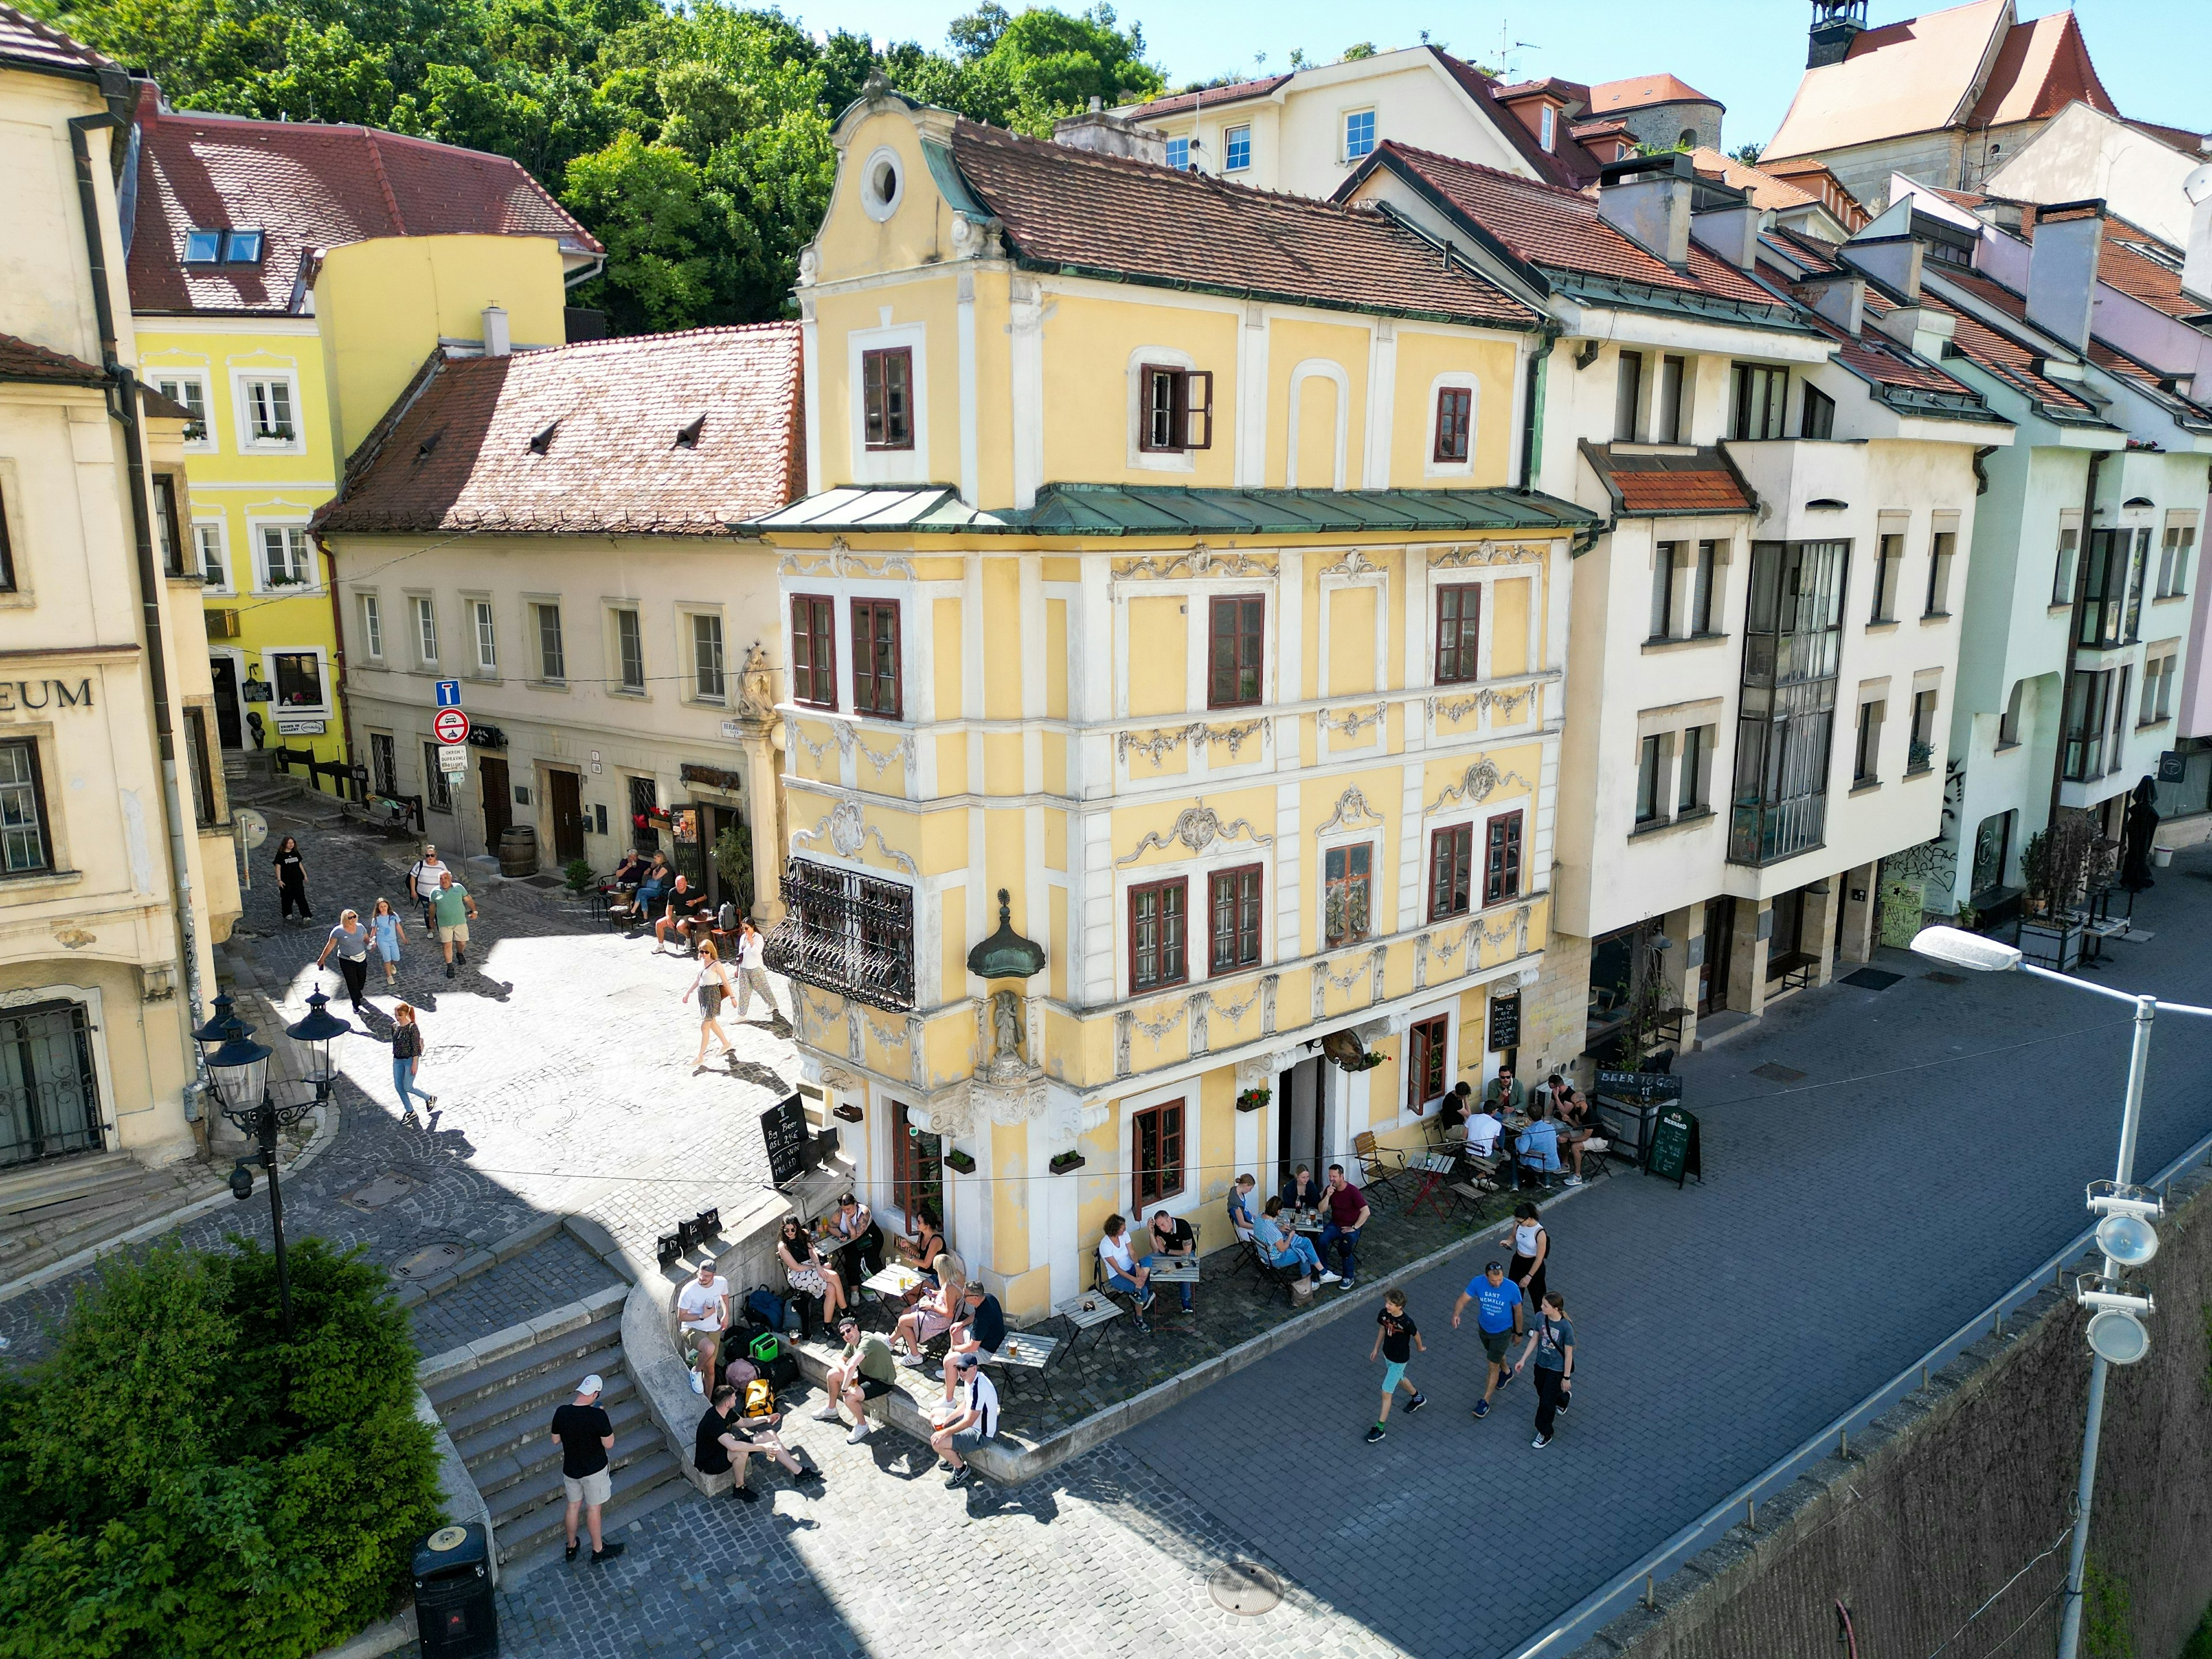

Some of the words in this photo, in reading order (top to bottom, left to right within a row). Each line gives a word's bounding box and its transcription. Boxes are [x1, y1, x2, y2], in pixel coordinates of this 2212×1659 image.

[1601, 1073, 1634, 1084] BEER
[1641, 1076, 1653, 1085] TO
[782, 1121, 797, 1132] Beer
[1664, 1117, 1687, 1130] BERNARD
[773, 1154, 782, 1165] HOT
[775, 1157, 796, 1176] MULLED
[1480, 1297, 1505, 1306] MCMXLIX
